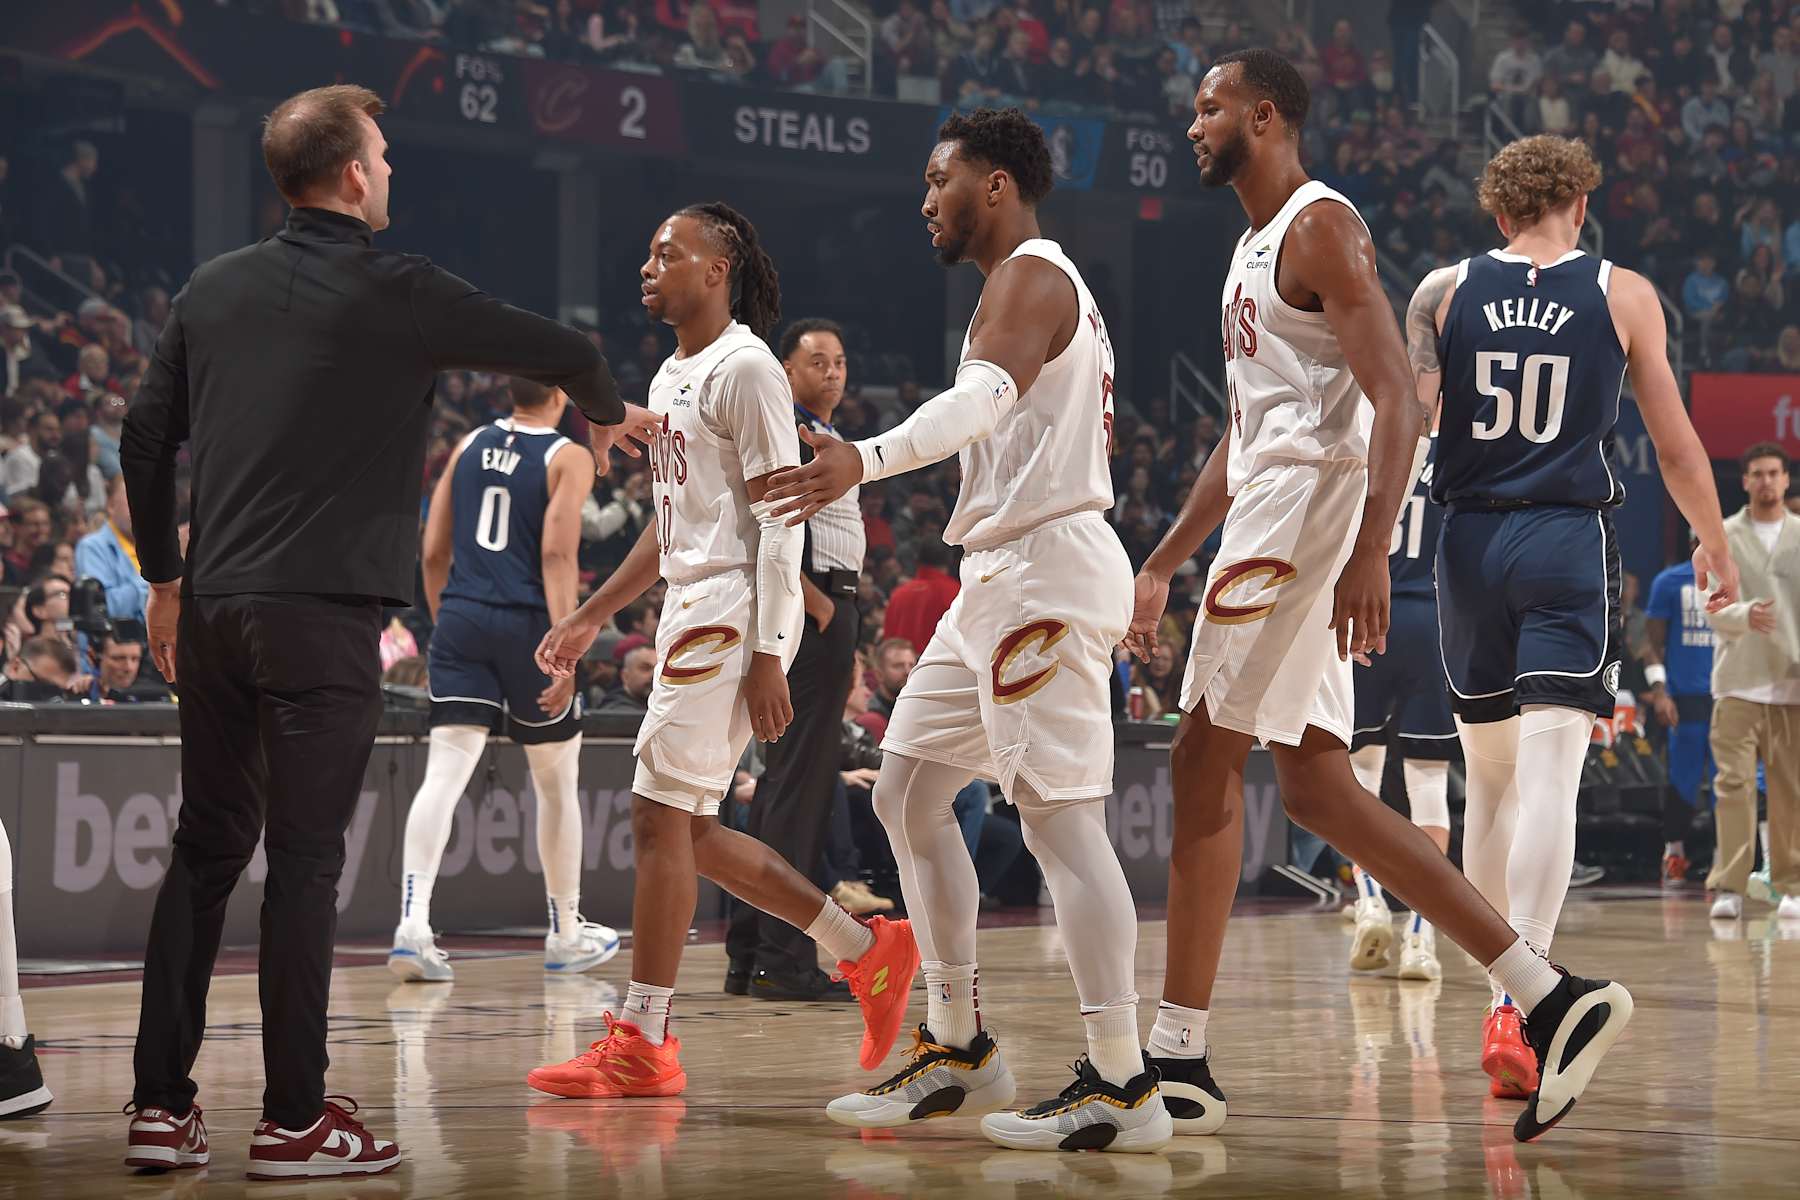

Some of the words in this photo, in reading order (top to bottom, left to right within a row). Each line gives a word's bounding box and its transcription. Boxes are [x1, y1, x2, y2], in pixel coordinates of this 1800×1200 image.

[460, 83, 497, 123] 62
[619, 86, 647, 139] 2
[735, 106, 870, 153] STEALS
[1130, 154, 1168, 187] 50
[1246, 261, 1269, 269] CLIFFS
[1483, 298, 1574, 335] KELLEY
[673, 398, 691, 408] CLIFFS
[1472, 352, 1570, 443] 50
[476, 485, 511, 551] 0
